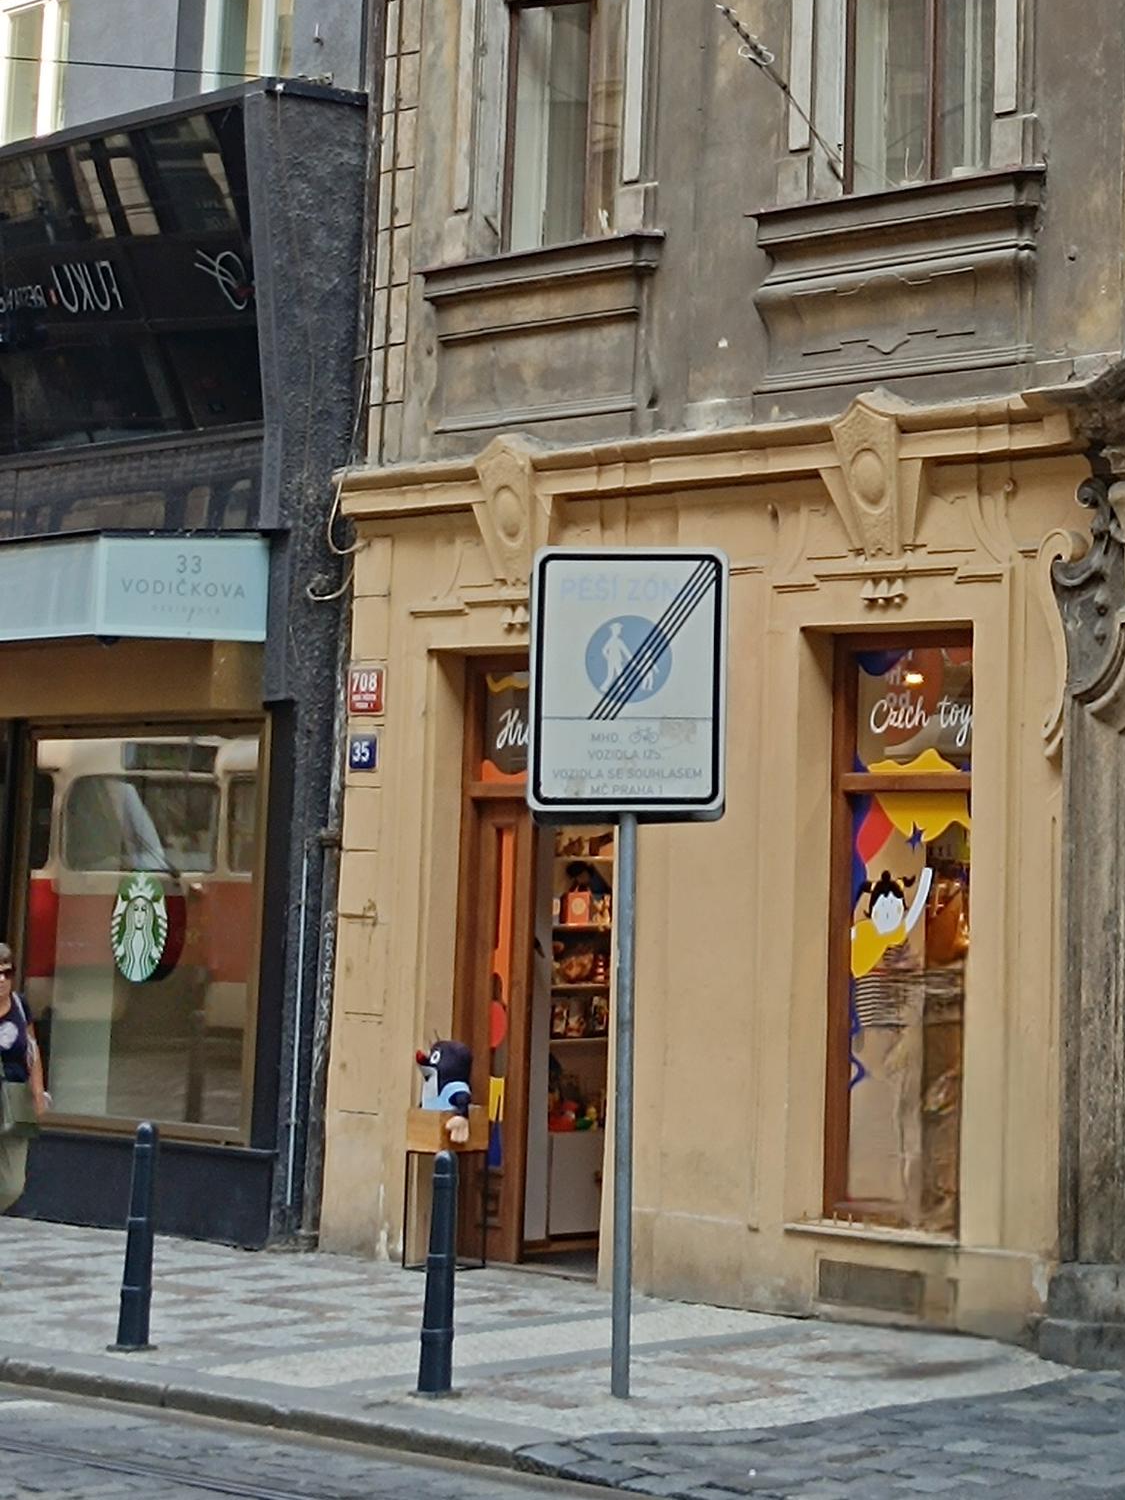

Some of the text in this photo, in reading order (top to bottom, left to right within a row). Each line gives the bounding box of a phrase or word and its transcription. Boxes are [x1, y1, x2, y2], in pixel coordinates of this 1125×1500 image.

[176, 555, 202, 574] 33
[121, 578, 245, 598] VODIČKOVA
[351, 672, 377, 692] 708
[870, 696, 931, 734] Czech
[351, 741, 370, 762] 35
[587, 749, 641, 761] VOZIDLA
[552, 766, 703, 780] VOZIDLA SE SOUHLASEM
[590, 781, 609, 795] MČ
[612, 784, 655, 795] PRAHA
